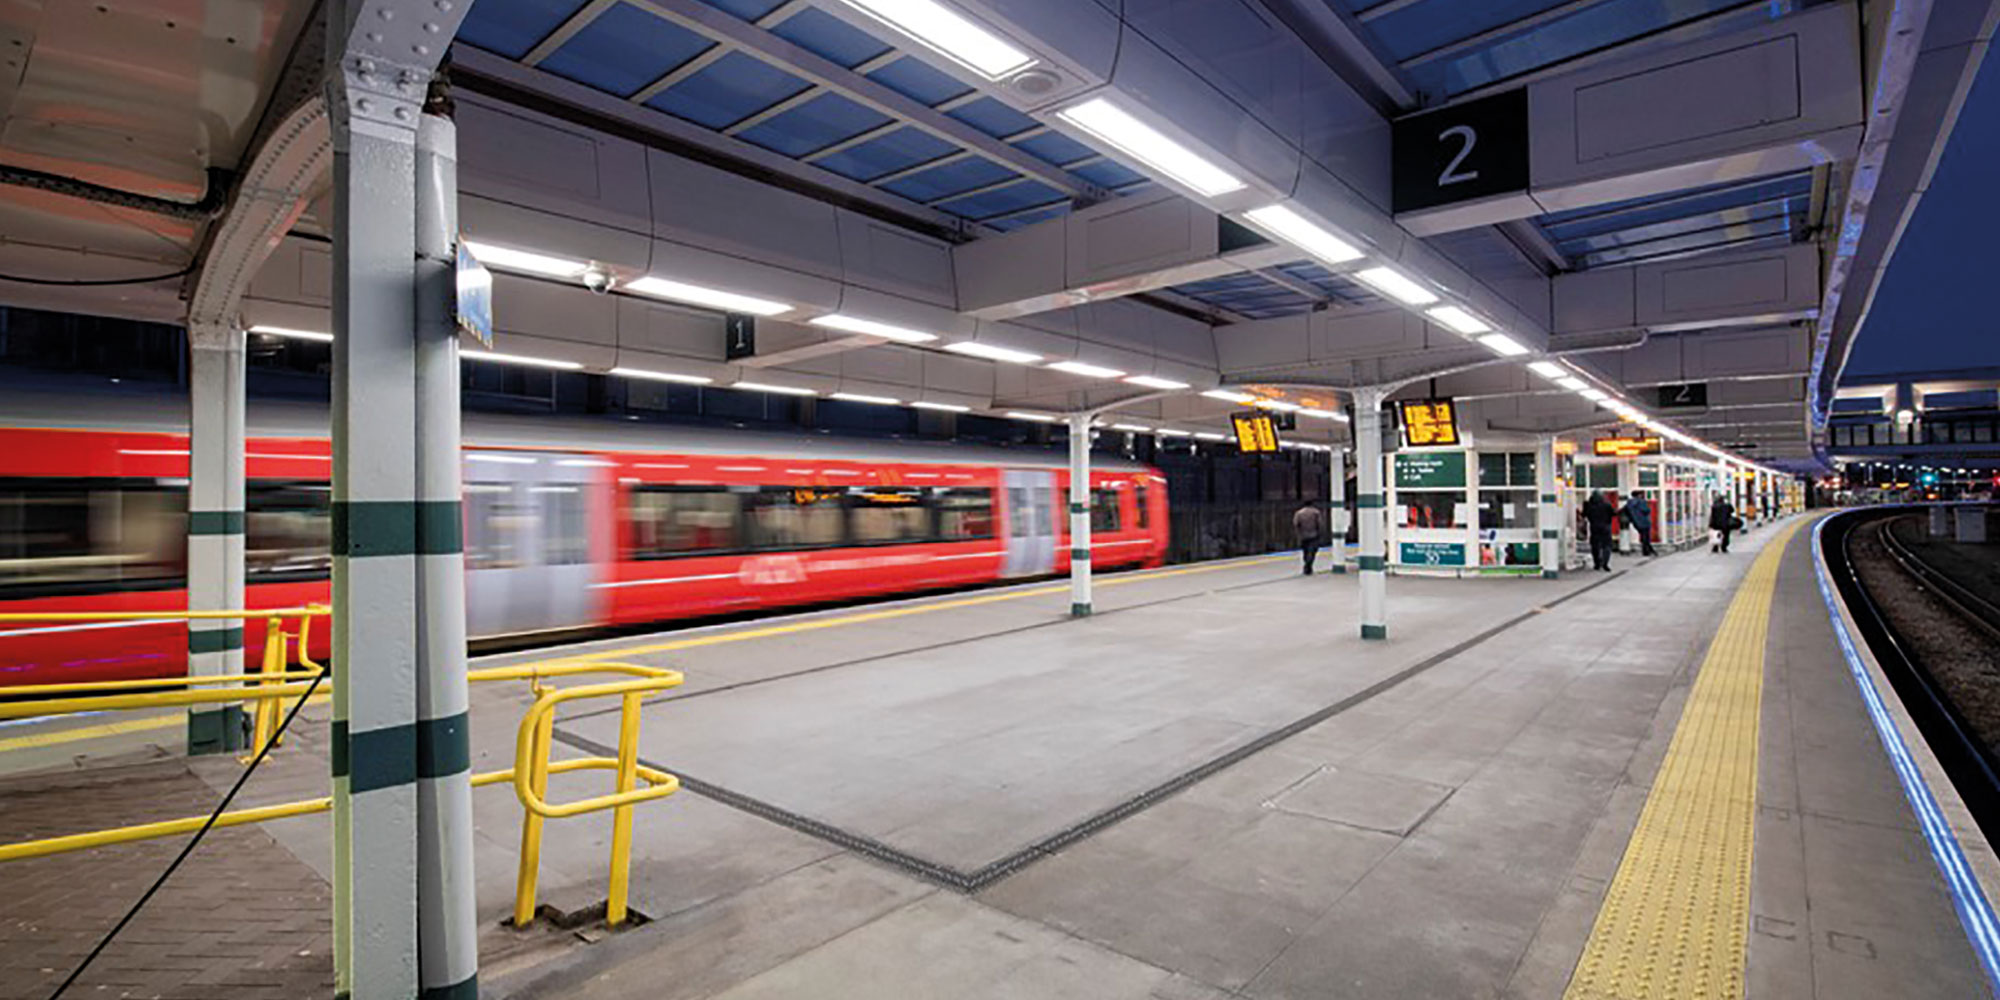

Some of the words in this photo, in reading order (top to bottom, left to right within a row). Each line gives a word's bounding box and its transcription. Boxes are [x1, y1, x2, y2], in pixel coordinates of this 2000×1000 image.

[1438, 125, 1478, 187] 2
[735, 320, 746, 349] 1
[1675, 384, 1691, 402] 2
